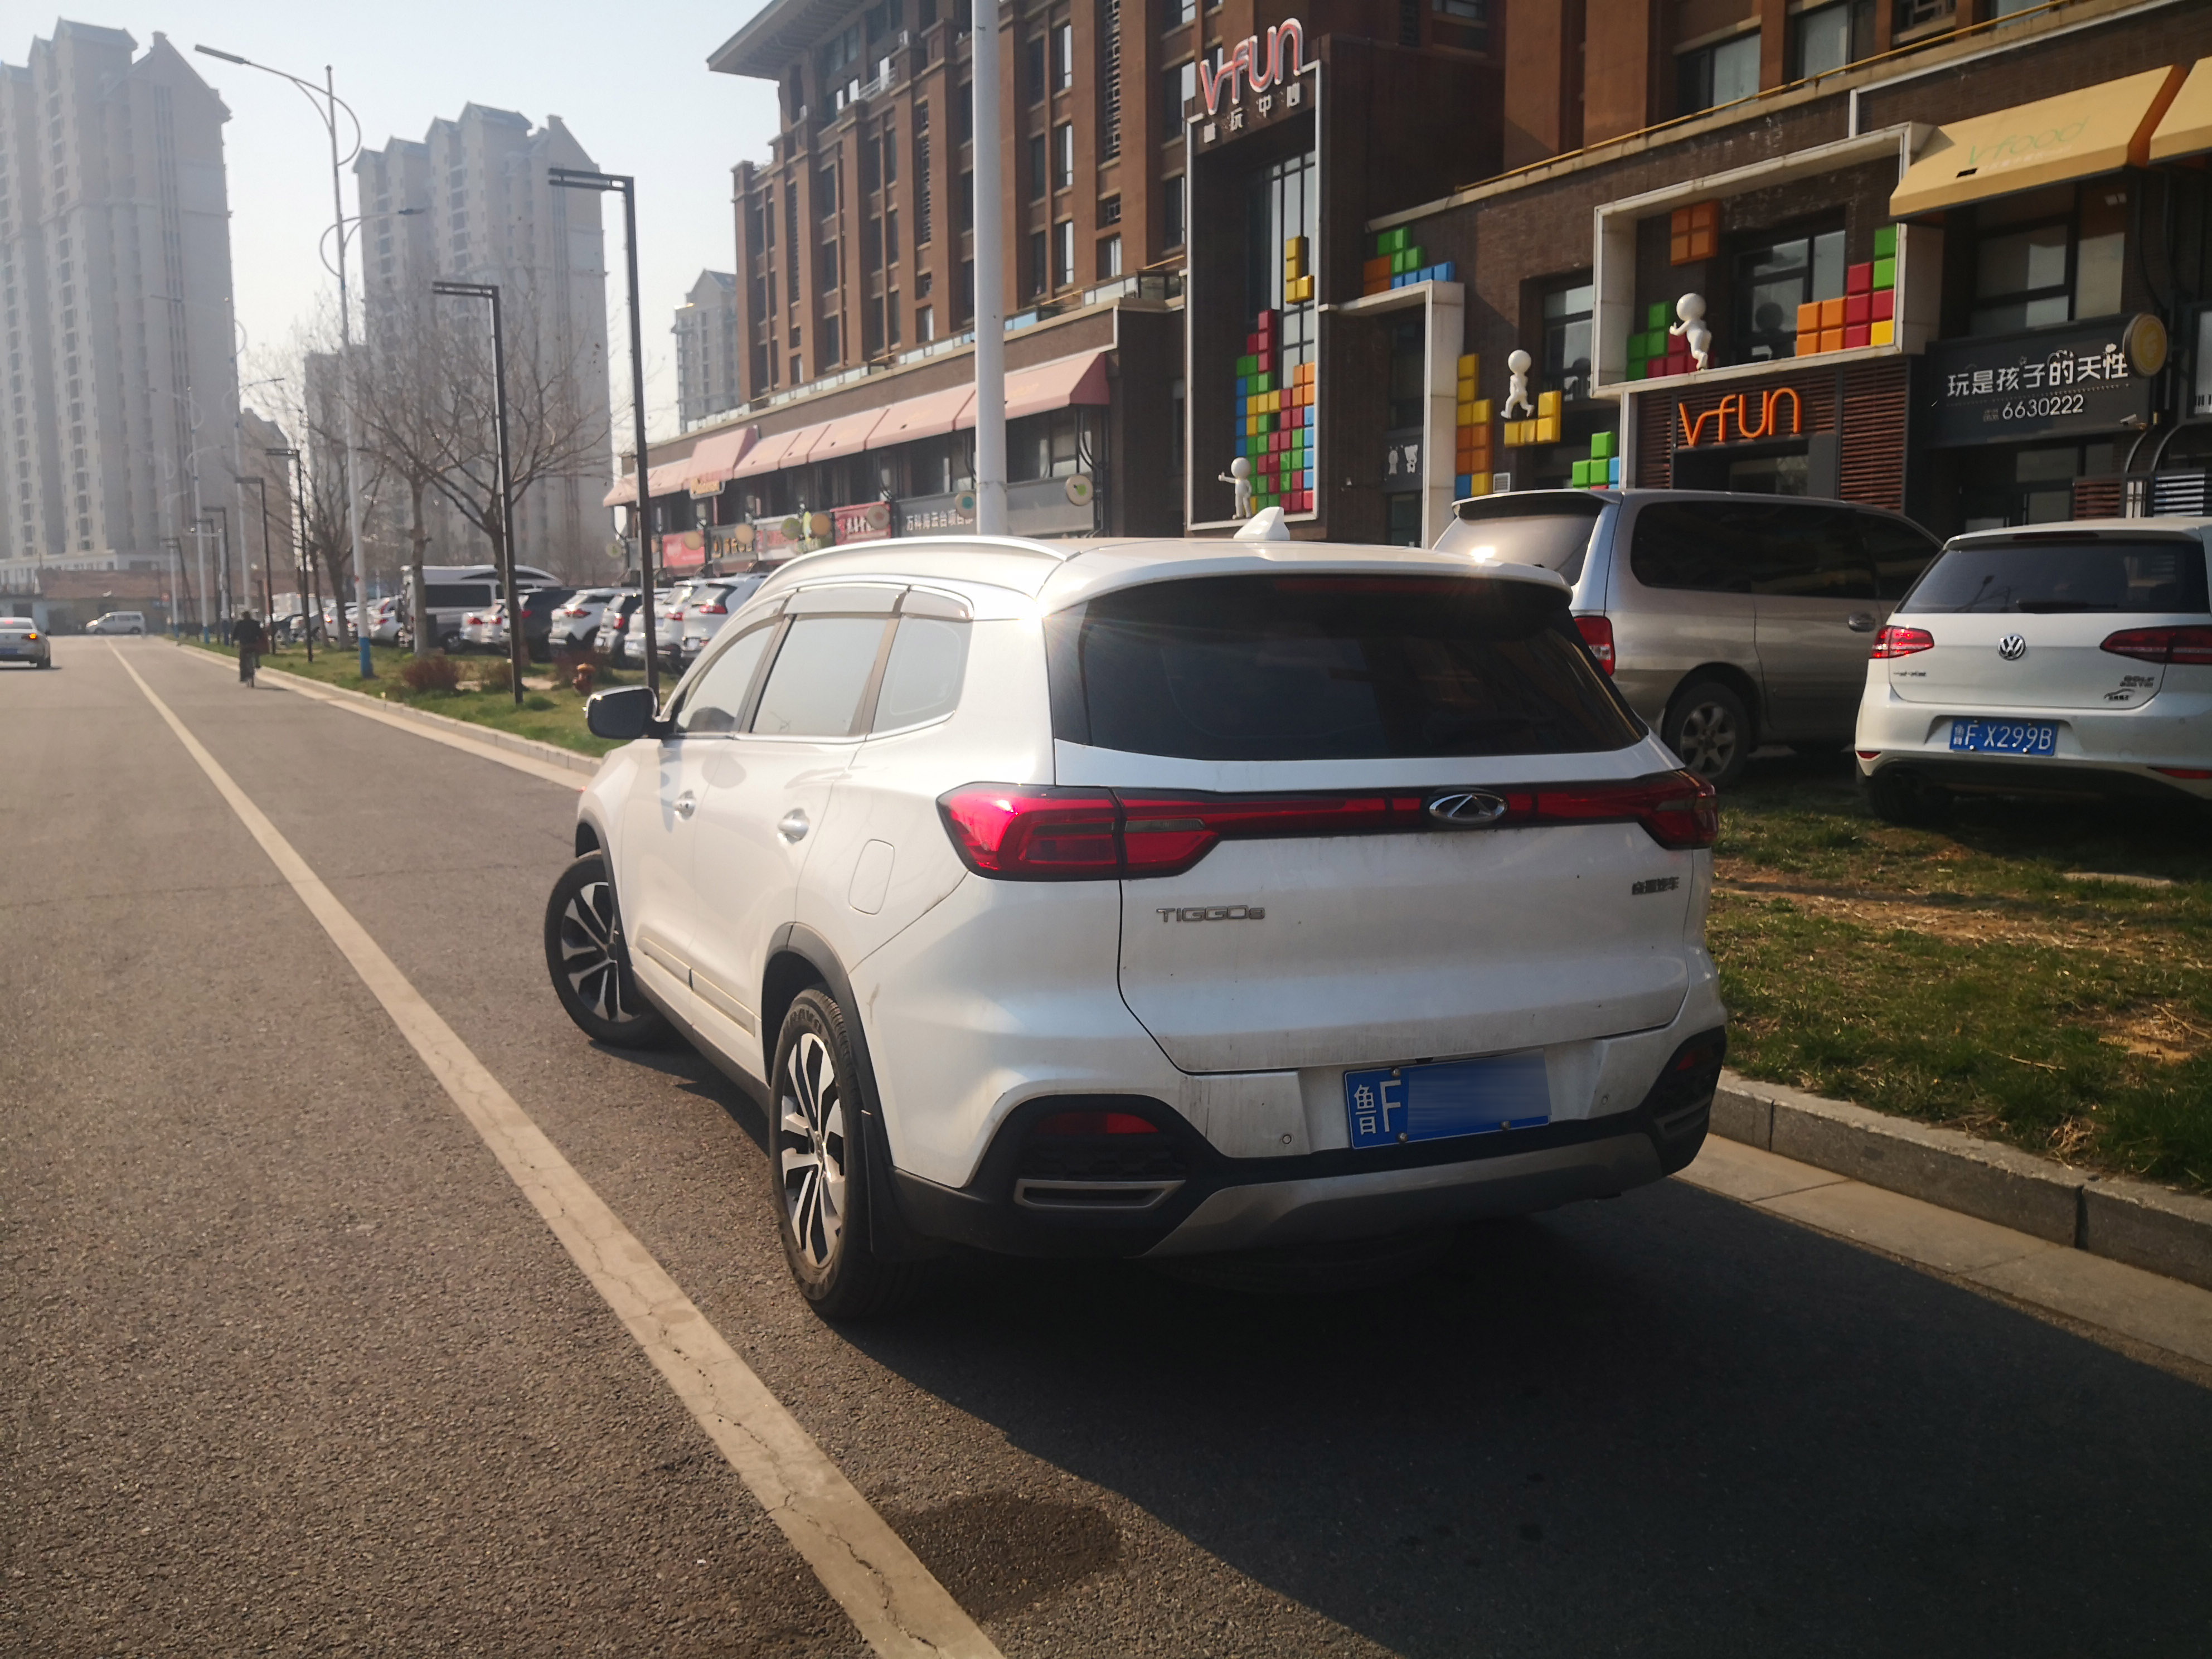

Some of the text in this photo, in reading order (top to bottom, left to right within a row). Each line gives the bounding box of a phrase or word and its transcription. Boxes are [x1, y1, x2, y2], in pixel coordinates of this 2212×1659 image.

[1947, 351, 2129, 396] 玩是孩子的天性
[2002, 395, 2084, 420] 6630222
